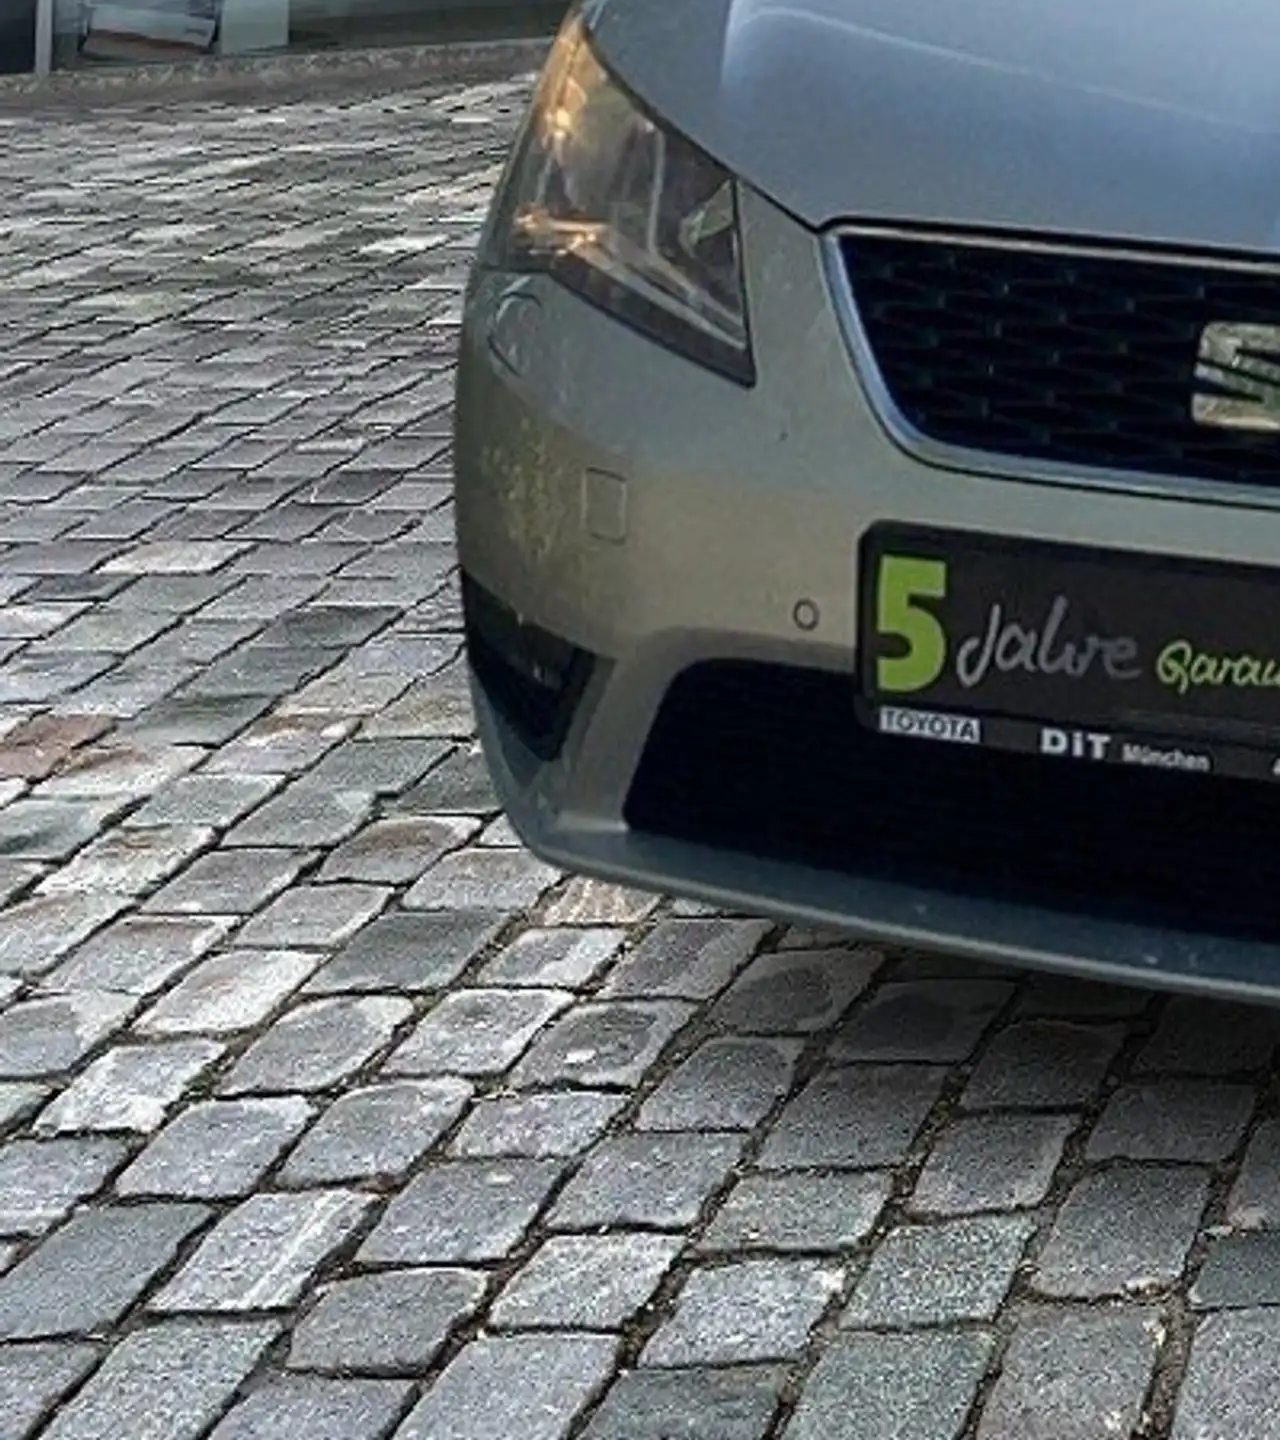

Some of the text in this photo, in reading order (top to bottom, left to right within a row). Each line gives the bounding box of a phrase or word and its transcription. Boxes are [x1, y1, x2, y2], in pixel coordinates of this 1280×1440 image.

[877, 554, 946, 692] 5
[956, 594, 1143, 688] Jahre
[882, 707, 979, 743] TOYOTA
